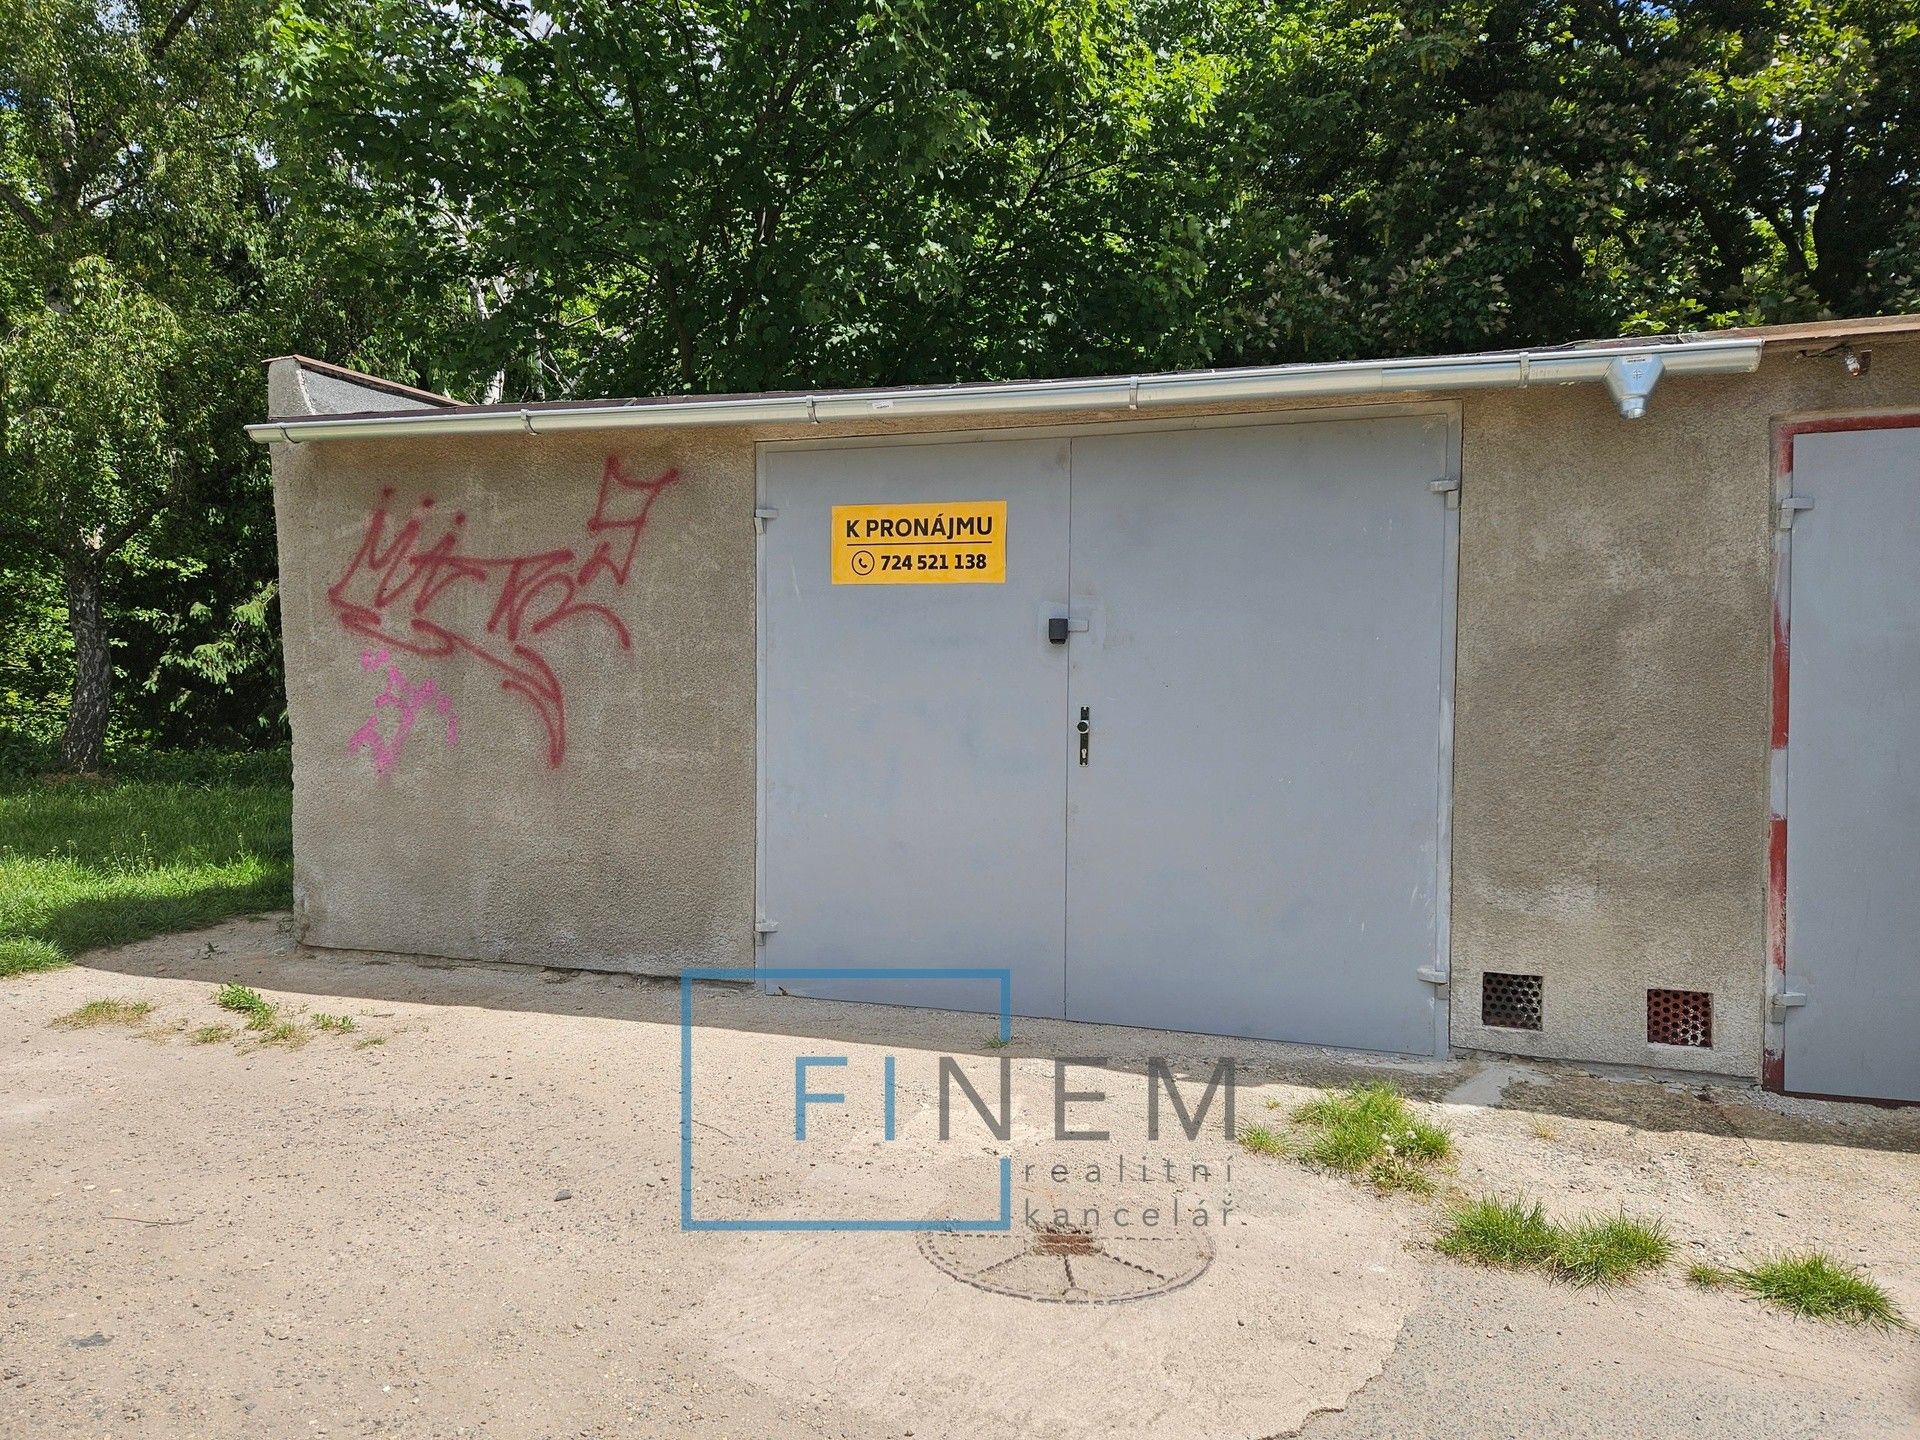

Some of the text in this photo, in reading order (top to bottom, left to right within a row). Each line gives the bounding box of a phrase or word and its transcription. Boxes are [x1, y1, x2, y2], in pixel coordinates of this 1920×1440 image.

[846, 513, 993, 540] K PRONÁJMU
[880, 553, 987, 571] 724 521 138
